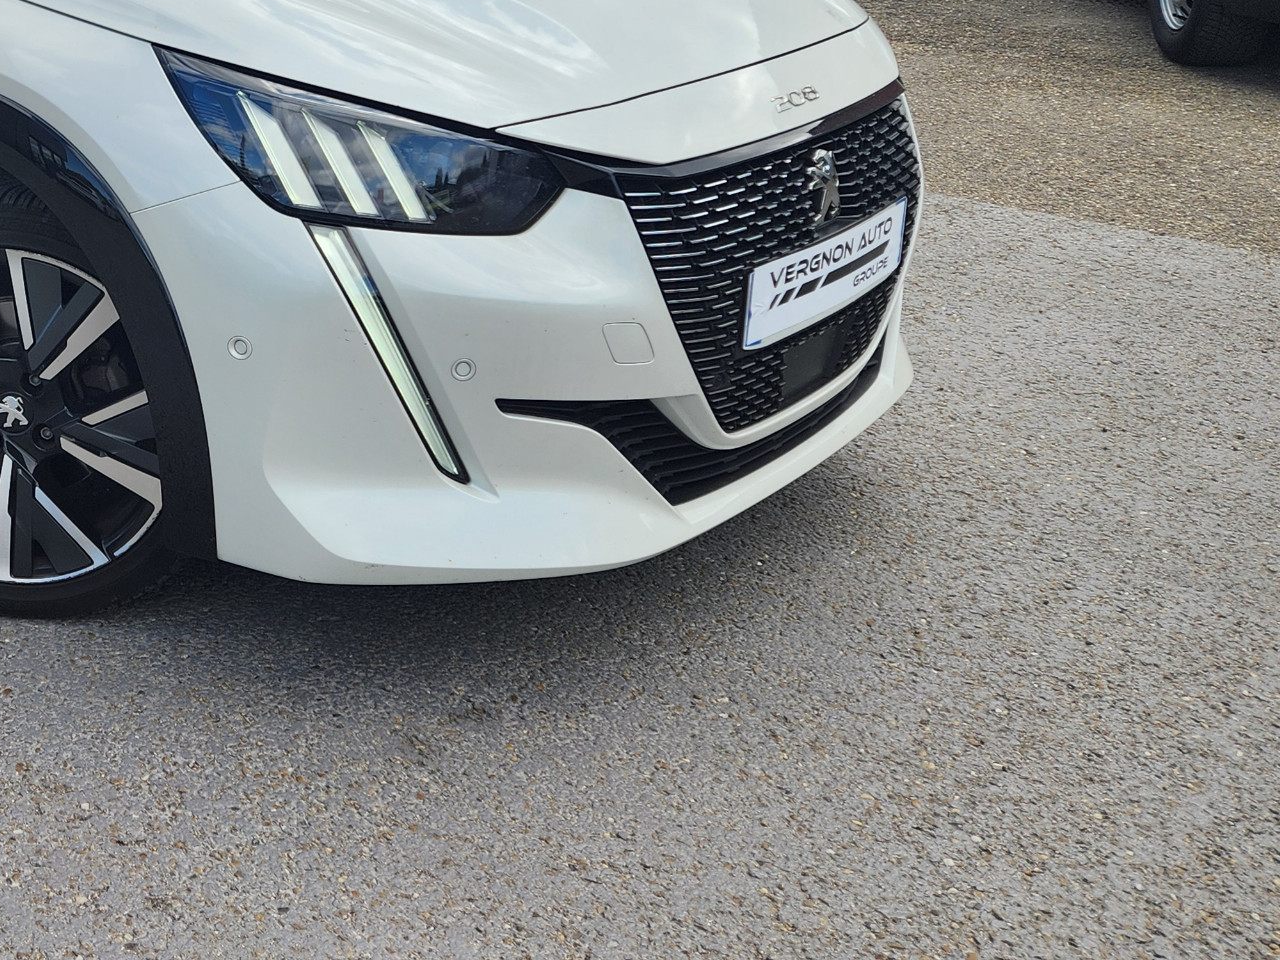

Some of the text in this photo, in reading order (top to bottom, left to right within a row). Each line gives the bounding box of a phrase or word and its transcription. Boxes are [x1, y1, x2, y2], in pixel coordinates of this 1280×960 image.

[771, 84, 820, 113] 208
[770, 217, 894, 289] VERGNON AUTO
[852, 257, 890, 288] GROUPE
